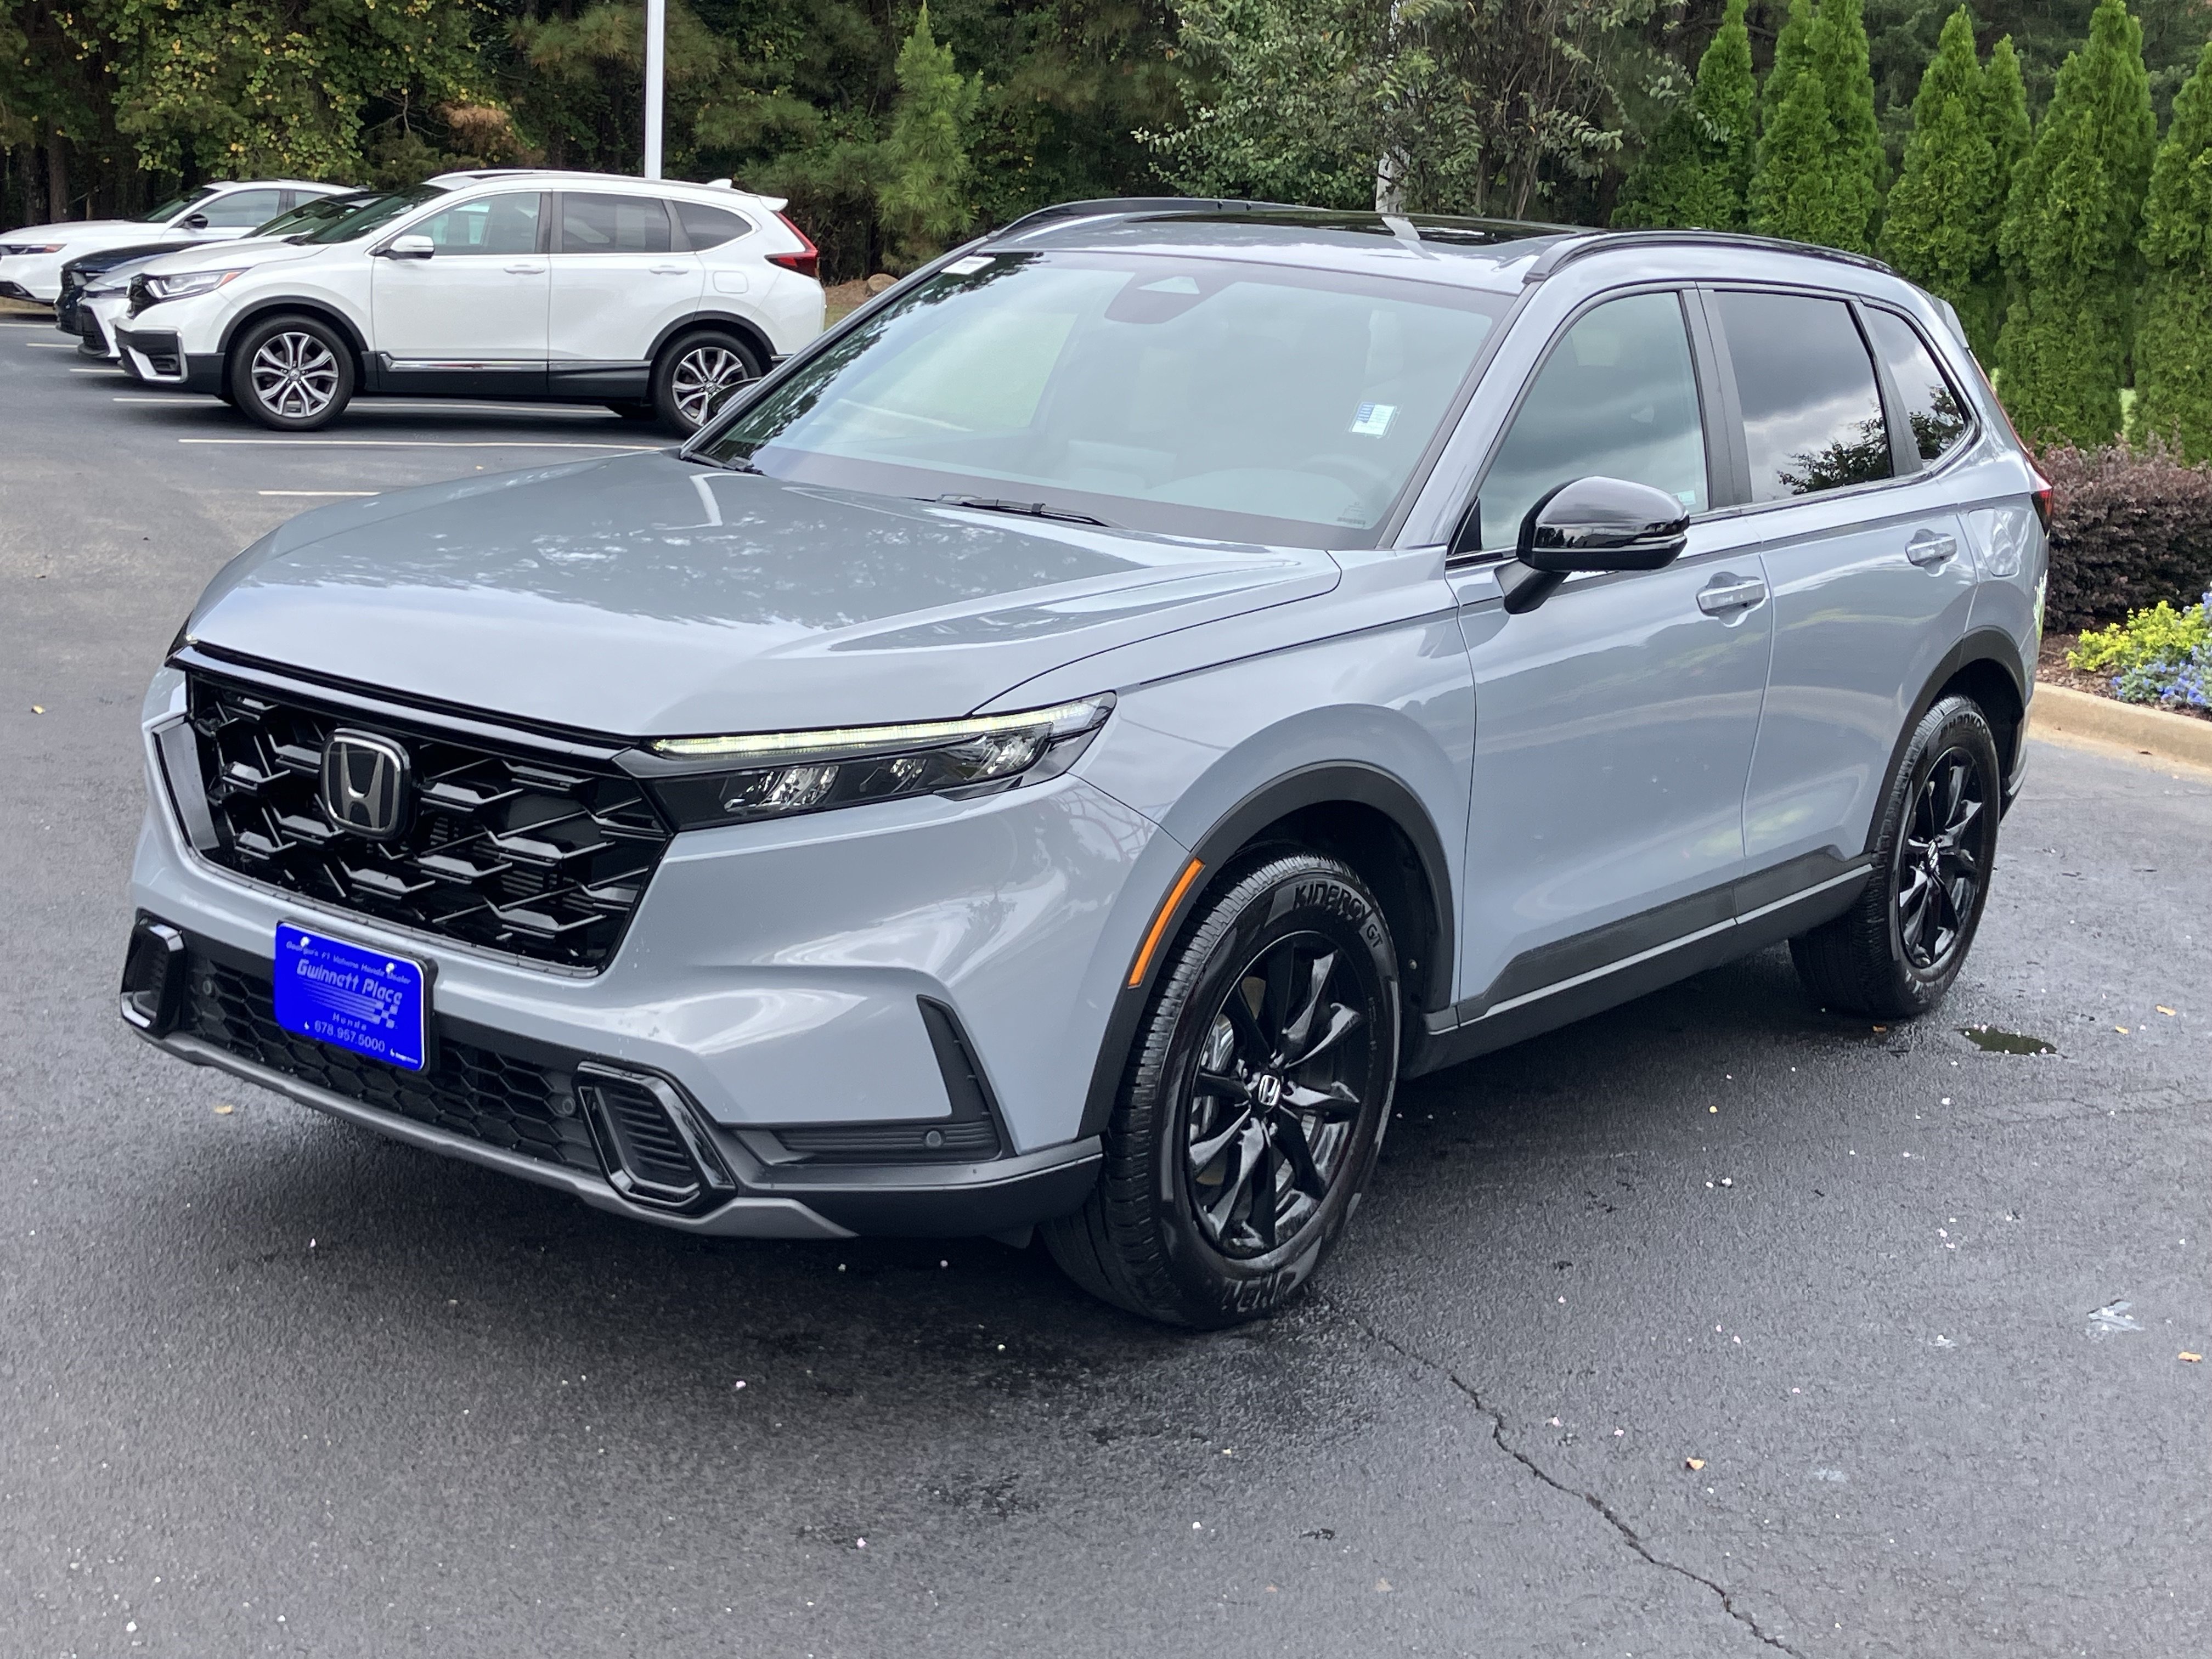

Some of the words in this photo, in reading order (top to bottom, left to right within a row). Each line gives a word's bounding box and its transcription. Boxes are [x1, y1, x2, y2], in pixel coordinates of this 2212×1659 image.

[1293, 882, 1373, 924] KINERGY
[1367, 923, 1383, 948] GT
[297, 958, 359, 991] Gwinnett
[362, 978, 403, 1006] Place
[361, 963, 385, 977] Honda
[332, 1012, 367, 1031] Honda
